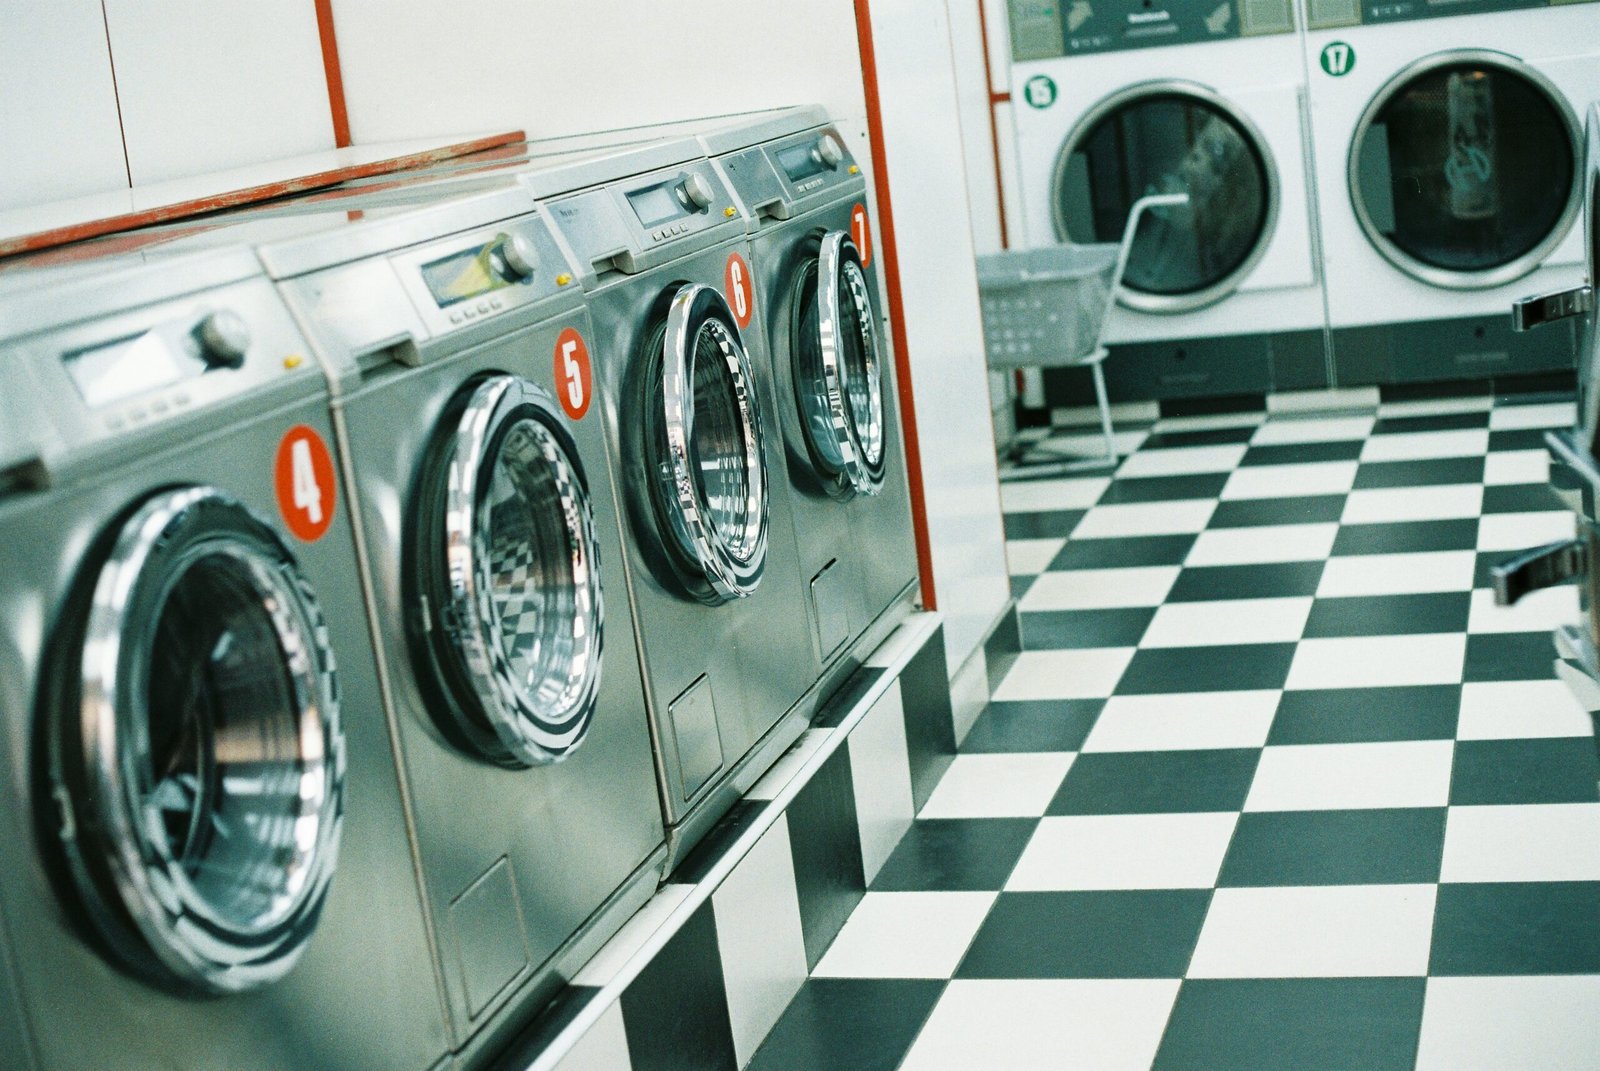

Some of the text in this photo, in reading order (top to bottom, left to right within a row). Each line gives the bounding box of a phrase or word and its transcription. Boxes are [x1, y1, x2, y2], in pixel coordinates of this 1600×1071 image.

[730, 260, 747, 319] 6
[562, 340, 584, 410] 5
[292, 438, 323, 524] 4
